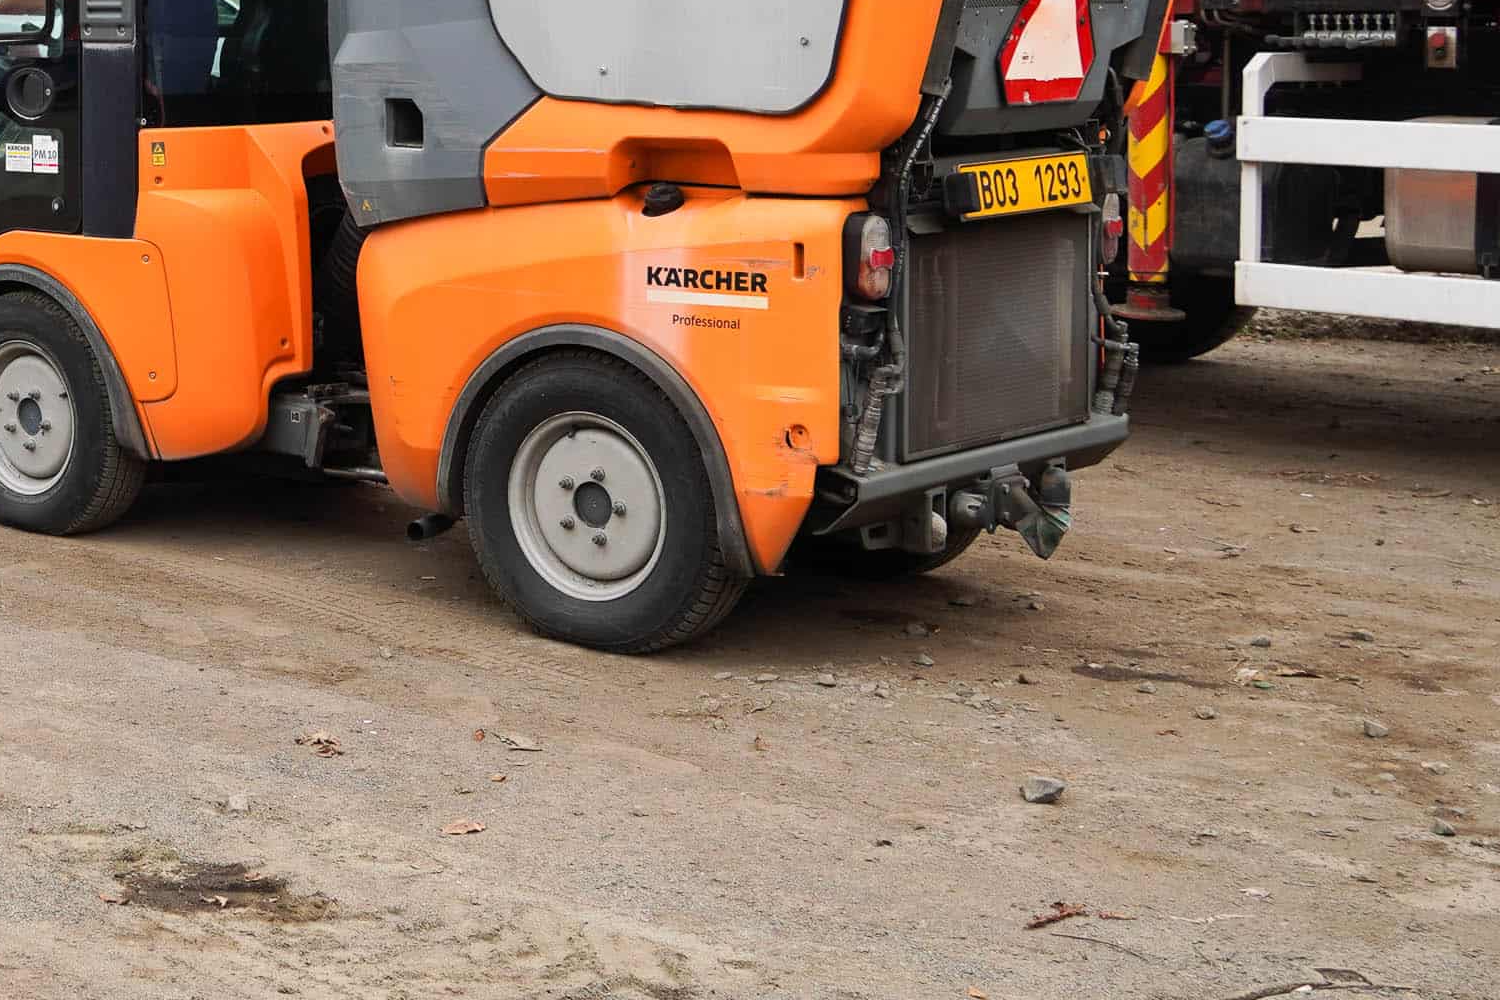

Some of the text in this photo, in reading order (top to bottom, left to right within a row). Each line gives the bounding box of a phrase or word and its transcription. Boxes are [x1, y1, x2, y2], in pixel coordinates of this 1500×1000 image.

[979, 160, 1082, 210] B03 1293
[647, 265, 768, 293] KÄRCHER
[672, 314, 741, 330] Professional
